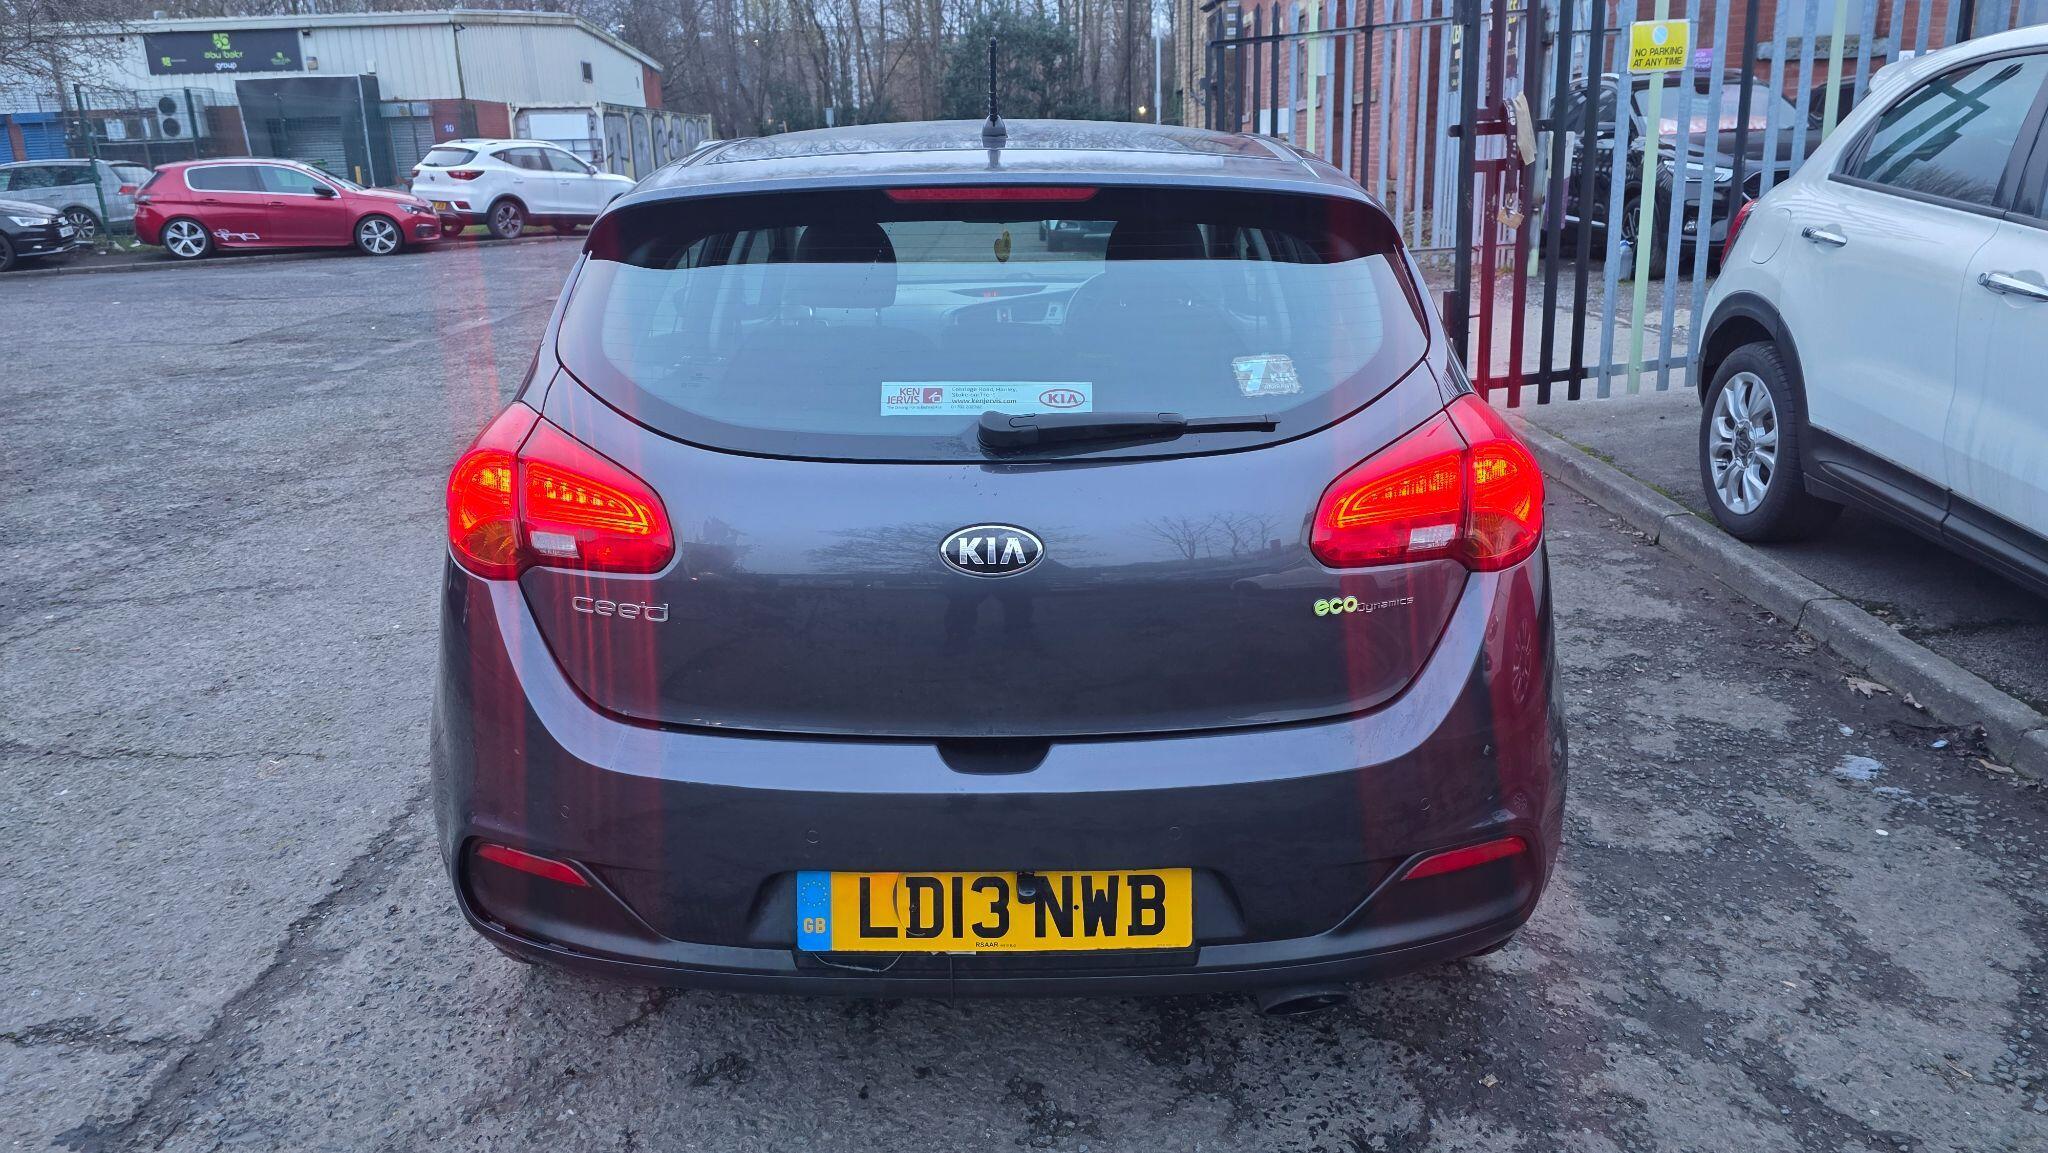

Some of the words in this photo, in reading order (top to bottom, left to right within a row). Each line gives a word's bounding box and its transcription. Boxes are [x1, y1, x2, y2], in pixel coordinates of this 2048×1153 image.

[1635, 48, 1647, 57] NO
[1649, 46, 1684, 56] PARKING
[215, 61, 238, 70] group
[1633, 59, 1643, 67] AT
[1645, 58, 1662, 66] ANY
[1664, 56, 1682, 65] TIME
[444, 124, 455, 133] 10
[899, 387, 920, 396] KEN
[886, 395, 920, 404] JERVIS
[1047, 394, 1079, 404] KIA
[958, 537, 1026, 564] KIA
[572, 596, 668, 622] cee'd
[859, 875, 1010, 939] LD13
[1034, 874, 1166, 938] NWB
[803, 917, 826, 934] GB
